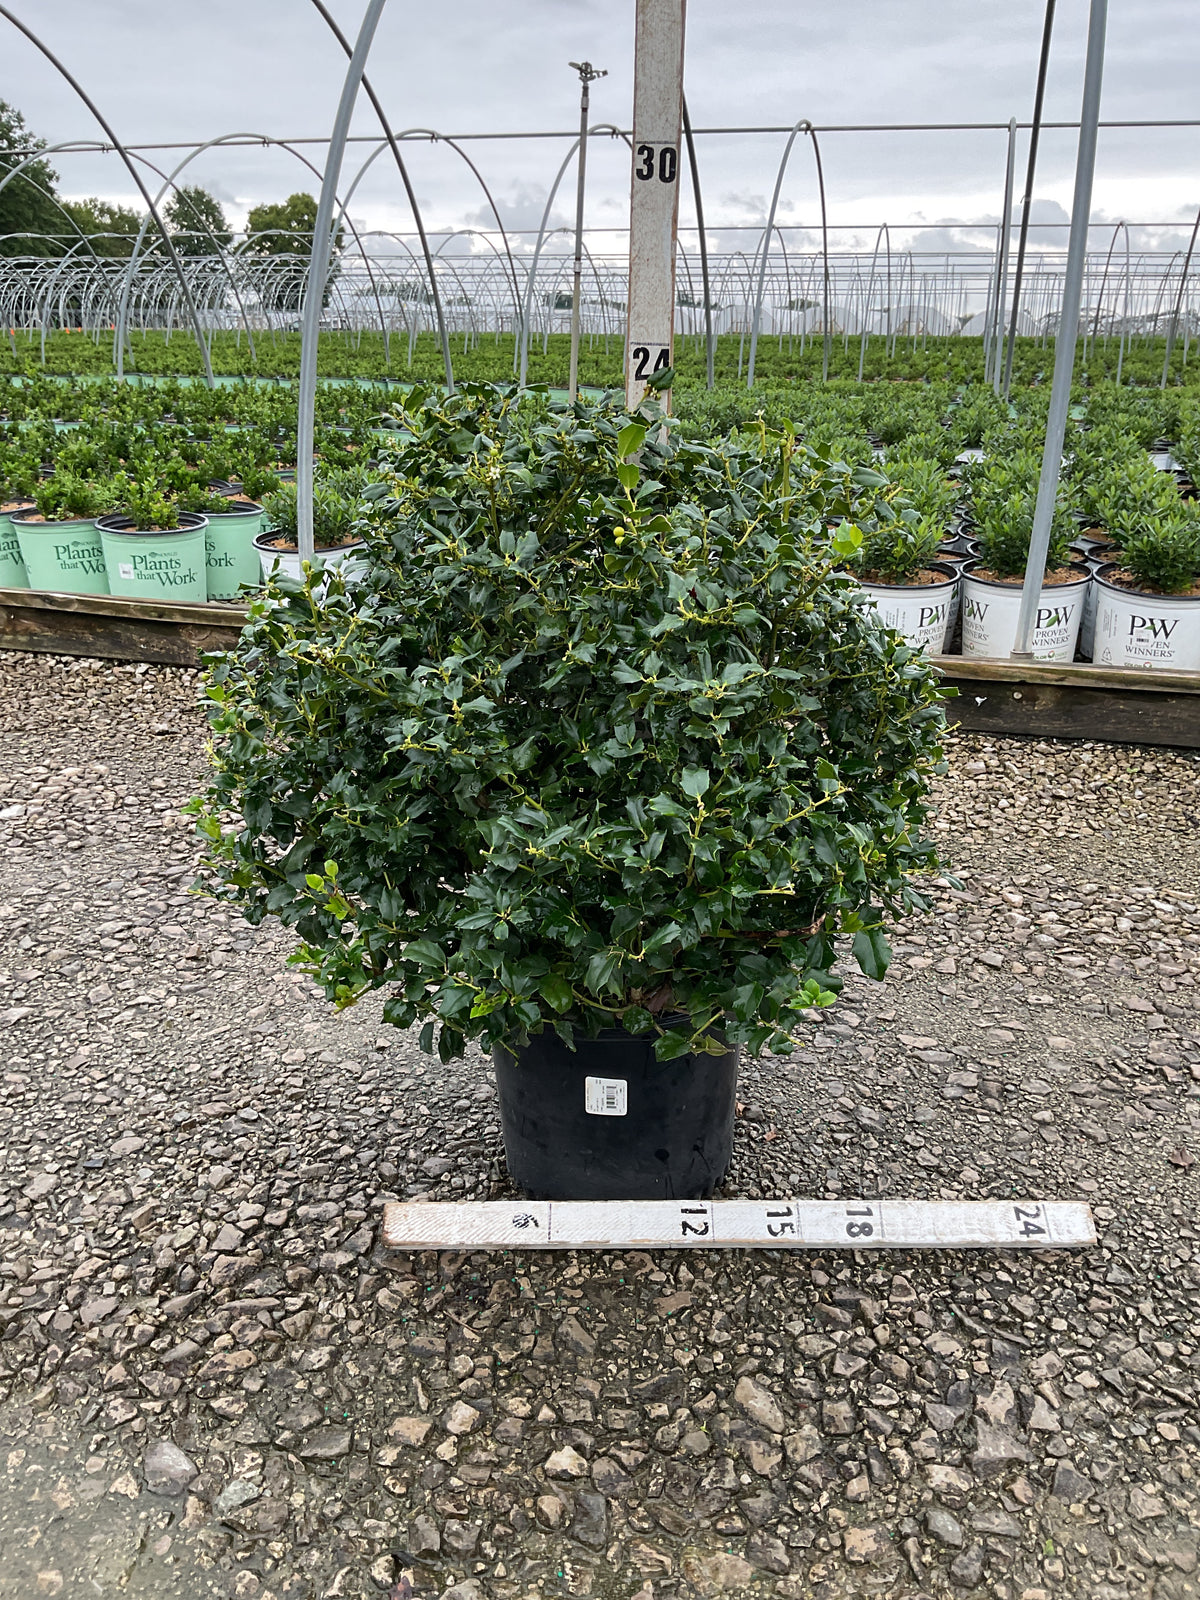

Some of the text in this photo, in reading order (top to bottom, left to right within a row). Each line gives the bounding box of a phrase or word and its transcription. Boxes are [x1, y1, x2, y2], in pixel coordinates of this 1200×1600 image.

[636, 144, 677, 183] 30
[633, 346, 670, 381] 24
[53, 545, 103, 560] Plants
[131, 555, 181, 571] Plants
[60, 560, 79, 570] that
[79, 559, 106, 575] Wo
[137, 571, 155, 580] that
[156, 568, 196, 587] Work
[1035, 604, 1075, 629] PW
[1128, 614, 1180, 640] PW
[1036, 627, 1069, 639] PROVEN
[1125, 644, 1173, 658] WINNERS
[680, 1207, 710, 1237] 12
[766, 1206, 796, 1238] 15
[845, 1206, 874, 1238] 18
[1013, 1205, 1046, 1238] 24
